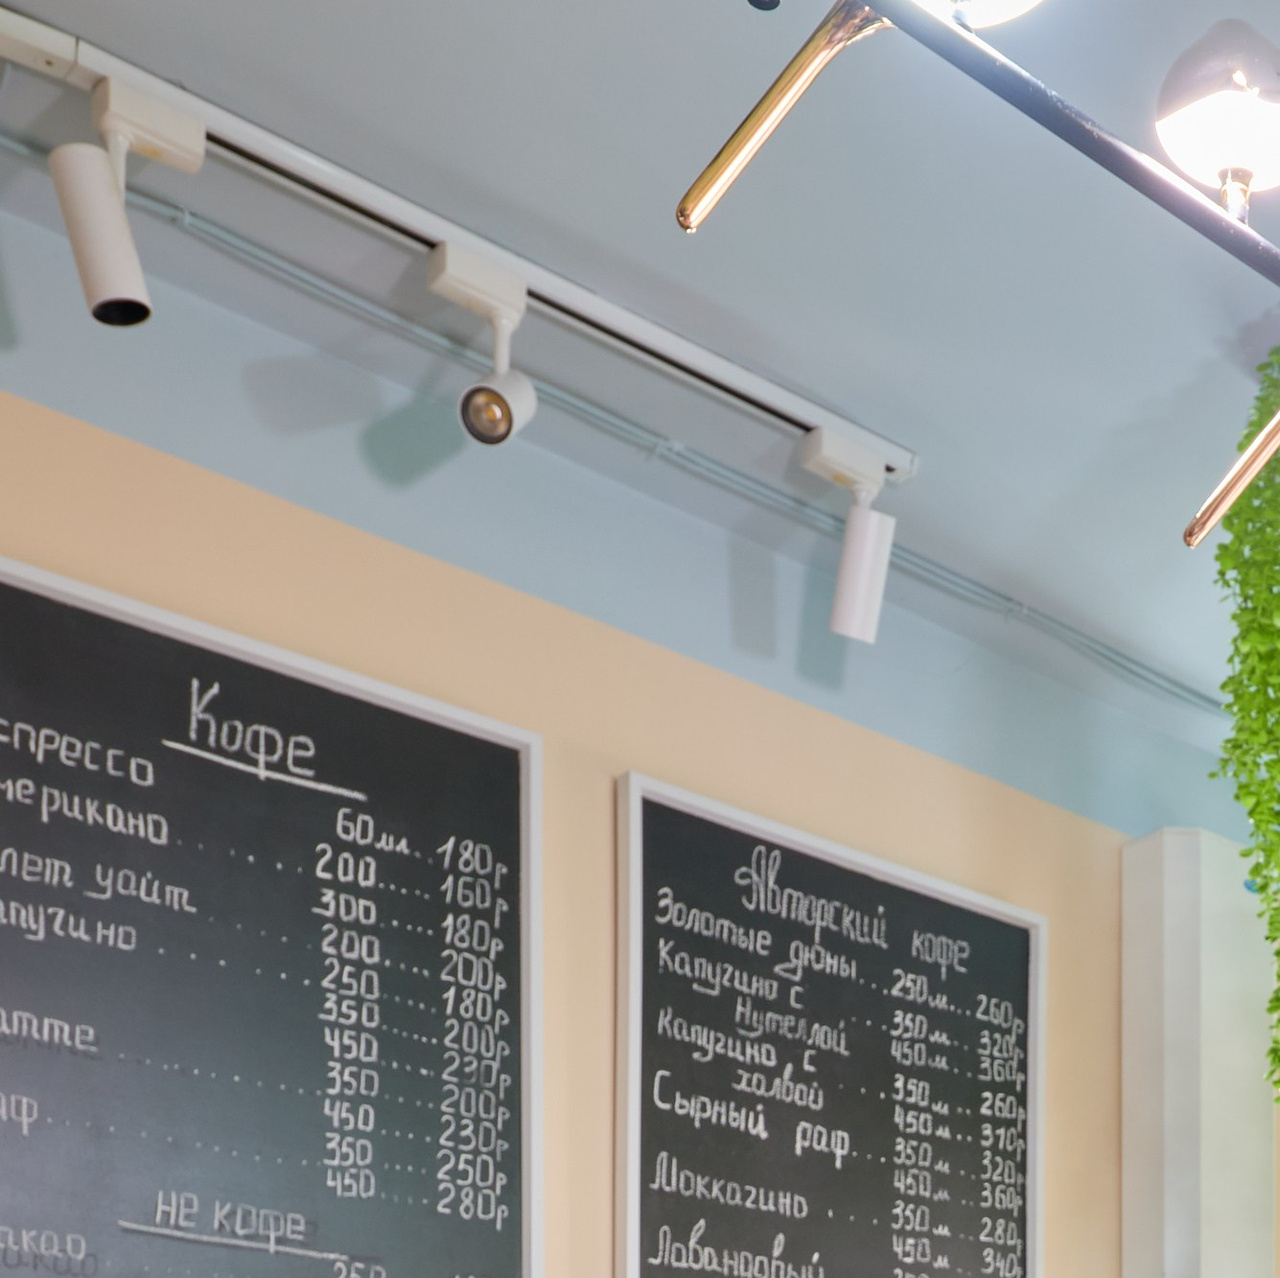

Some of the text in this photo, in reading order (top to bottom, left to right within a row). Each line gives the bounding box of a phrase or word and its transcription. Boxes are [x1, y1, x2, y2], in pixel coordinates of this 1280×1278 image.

[189, 678, 316, 780] Кофе
[315, 843, 376, 888] 200
[83, 863, 197, 914] уайт
[322, 923, 380, 965] 200
[311, 888, 377, 925] 300
[734, 845, 970, 981] Авторский кофе
[655, 887, 772, 955] Золотые
[773, 940, 856, 982] дюны
[321, 957, 379, 1000] 250
[659, 937, 778, 996] Капучино
[790, 986, 804, 1009] с
[318, 993, 380, 1028] 350
[735, 996, 850, 1056] Нутеллой
[324, 1026, 378, 1062] 450
[658, 1006, 777, 1067] Капучино
[803, 1050, 817, 1072] с
[326, 1061, 379, 1097] 350
[731, 1063, 824, 1111] халвой
[324, 1098, 375, 1132] 450
[653, 1069, 769, 1140] Сырный
[795, 1121, 850, 1170] раф
[323, 1132, 372, 1166] 350
[326, 1168, 375, 1198] 450
[649, 1151, 808, 1218] Моккачино
